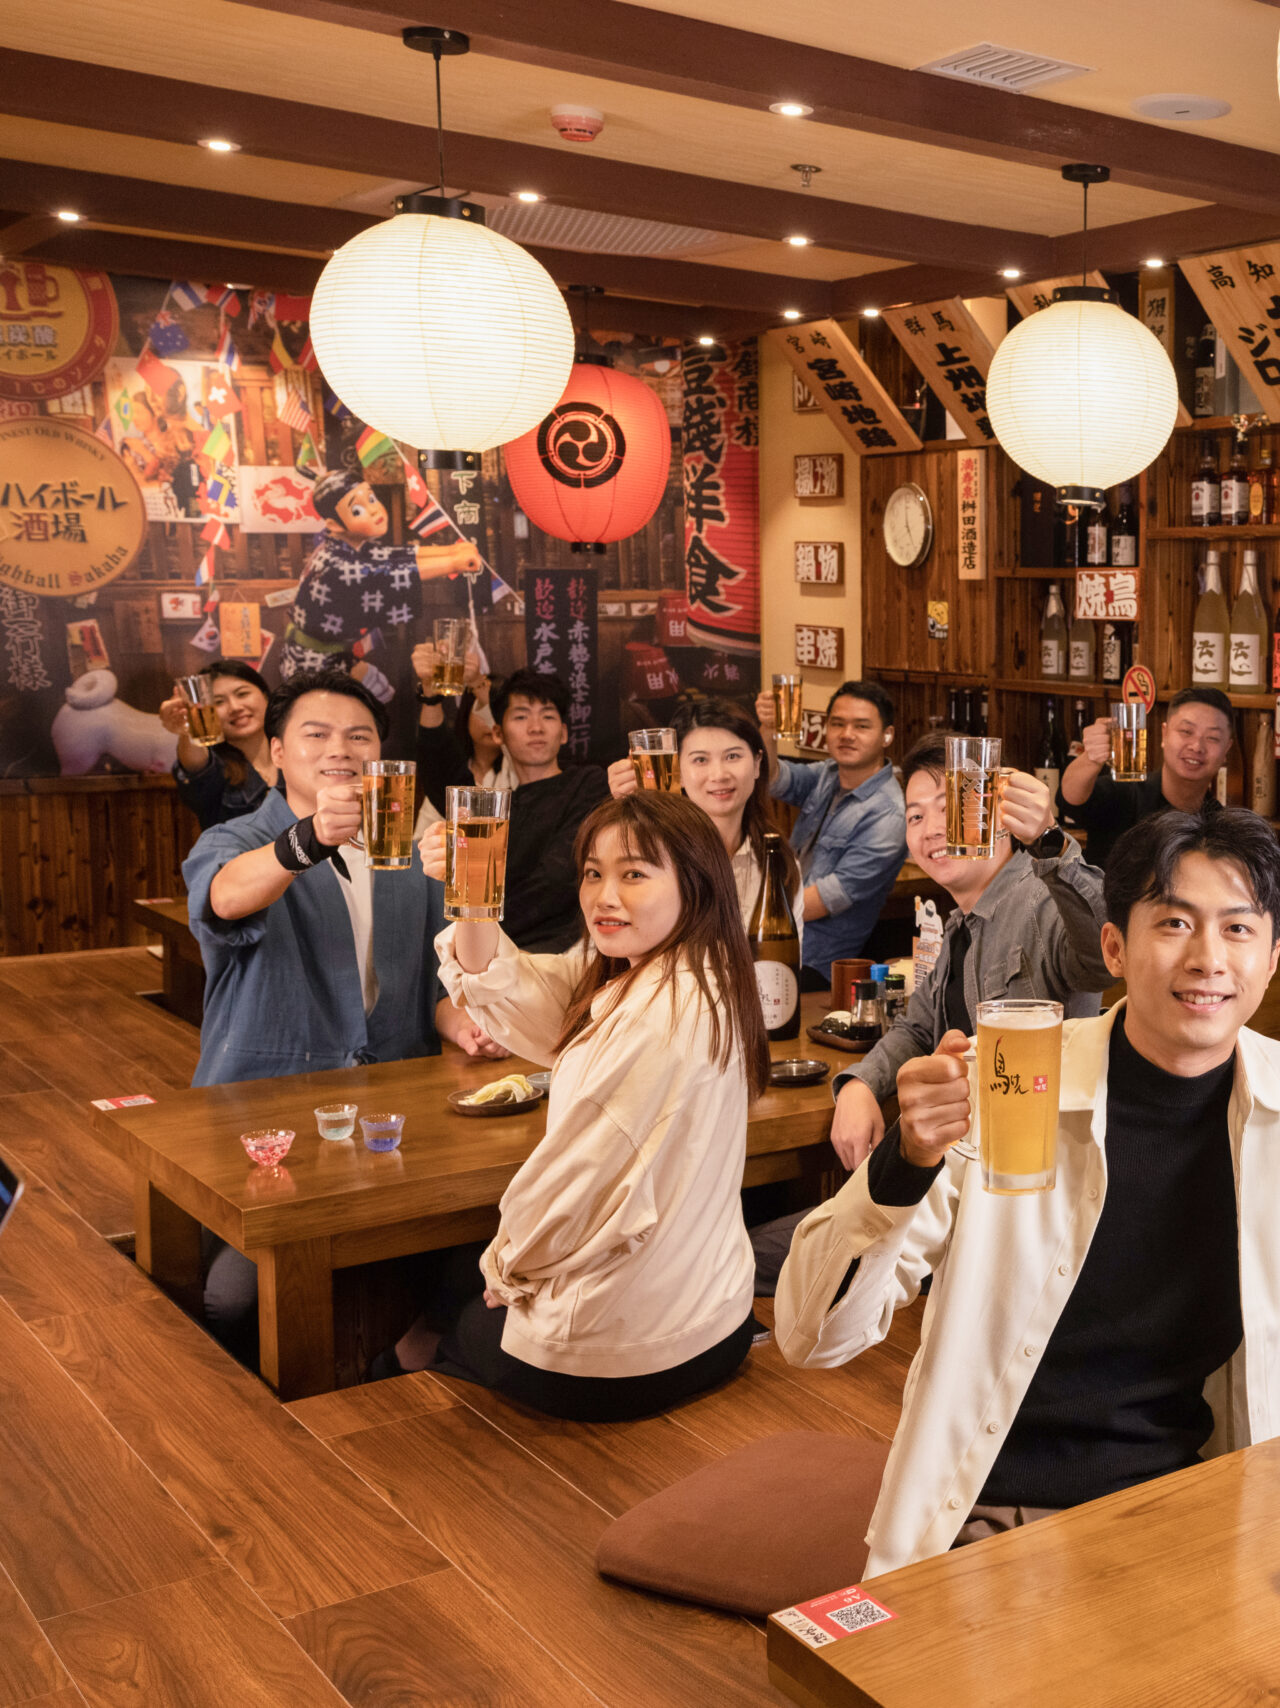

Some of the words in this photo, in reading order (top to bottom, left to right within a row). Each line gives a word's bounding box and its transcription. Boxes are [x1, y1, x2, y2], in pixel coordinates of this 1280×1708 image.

[1206, 260, 1276, 291] 高知
[1, 480, 129, 511] ハイボール
[10, 511, 88, 543] 酒場
